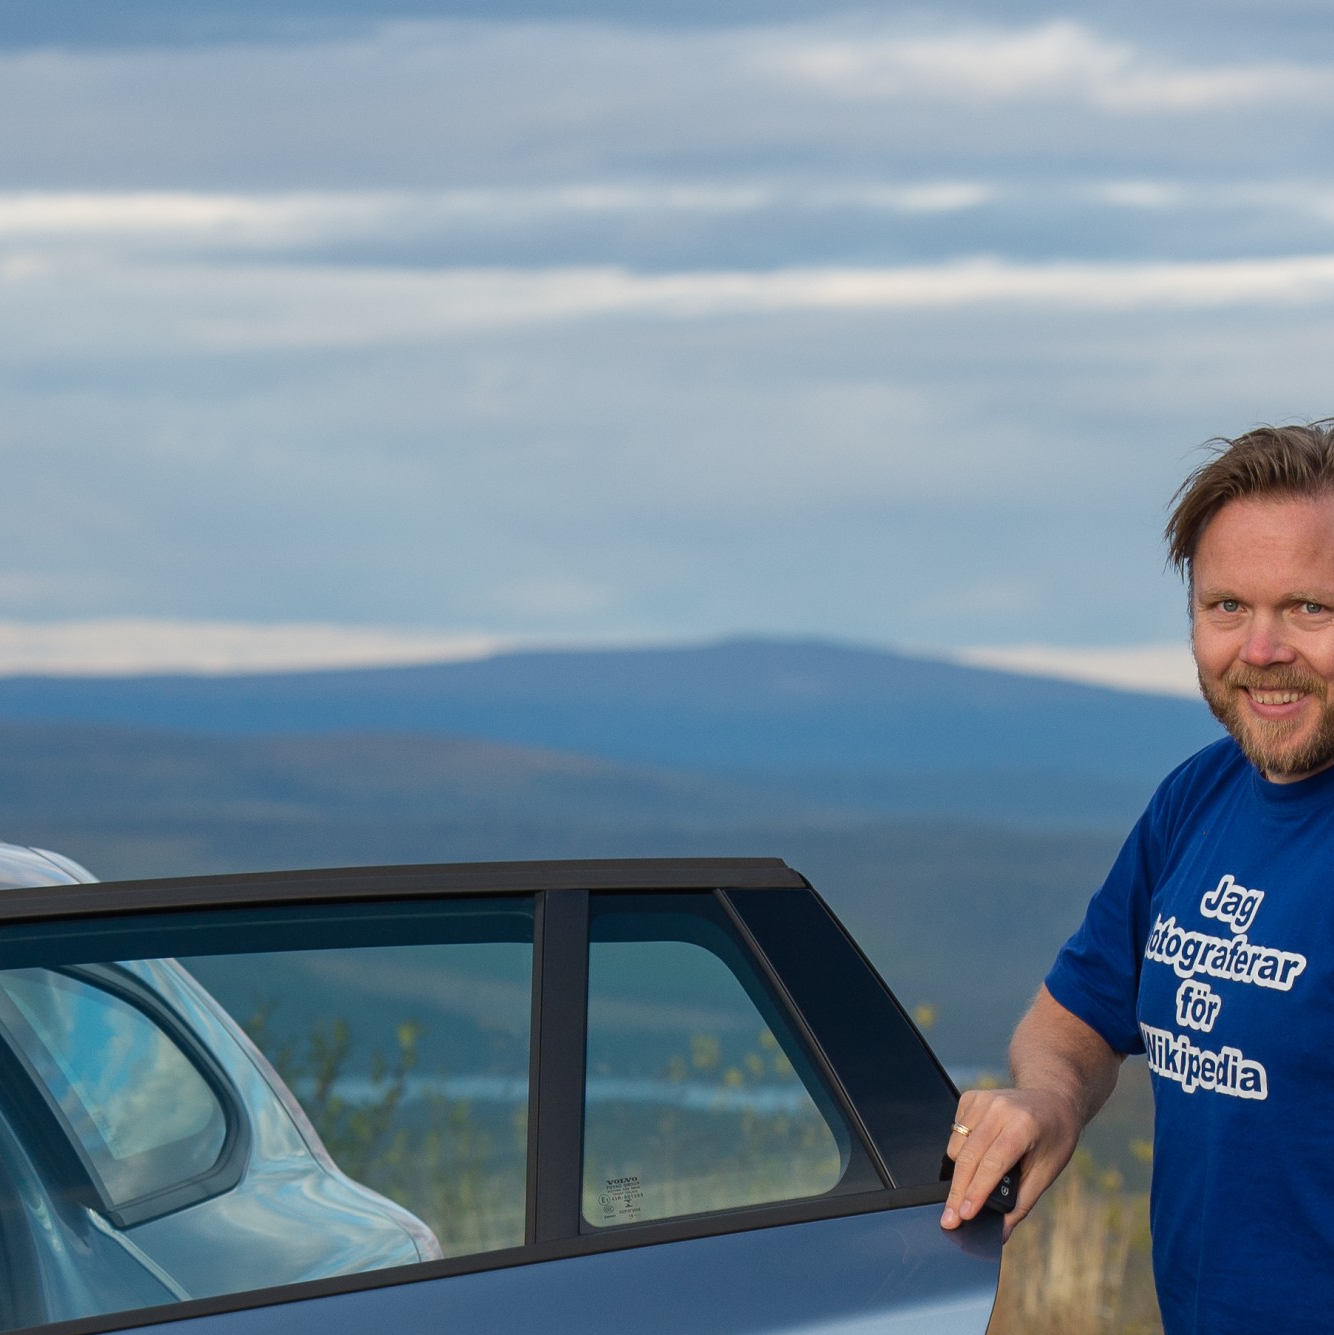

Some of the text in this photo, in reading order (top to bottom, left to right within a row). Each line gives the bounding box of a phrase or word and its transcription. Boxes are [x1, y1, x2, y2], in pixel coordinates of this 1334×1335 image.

[1202, 877, 1261, 930] Jag
[1178, 983, 1219, 1029] för
[606, 1176, 638, 1185] VOLVO
